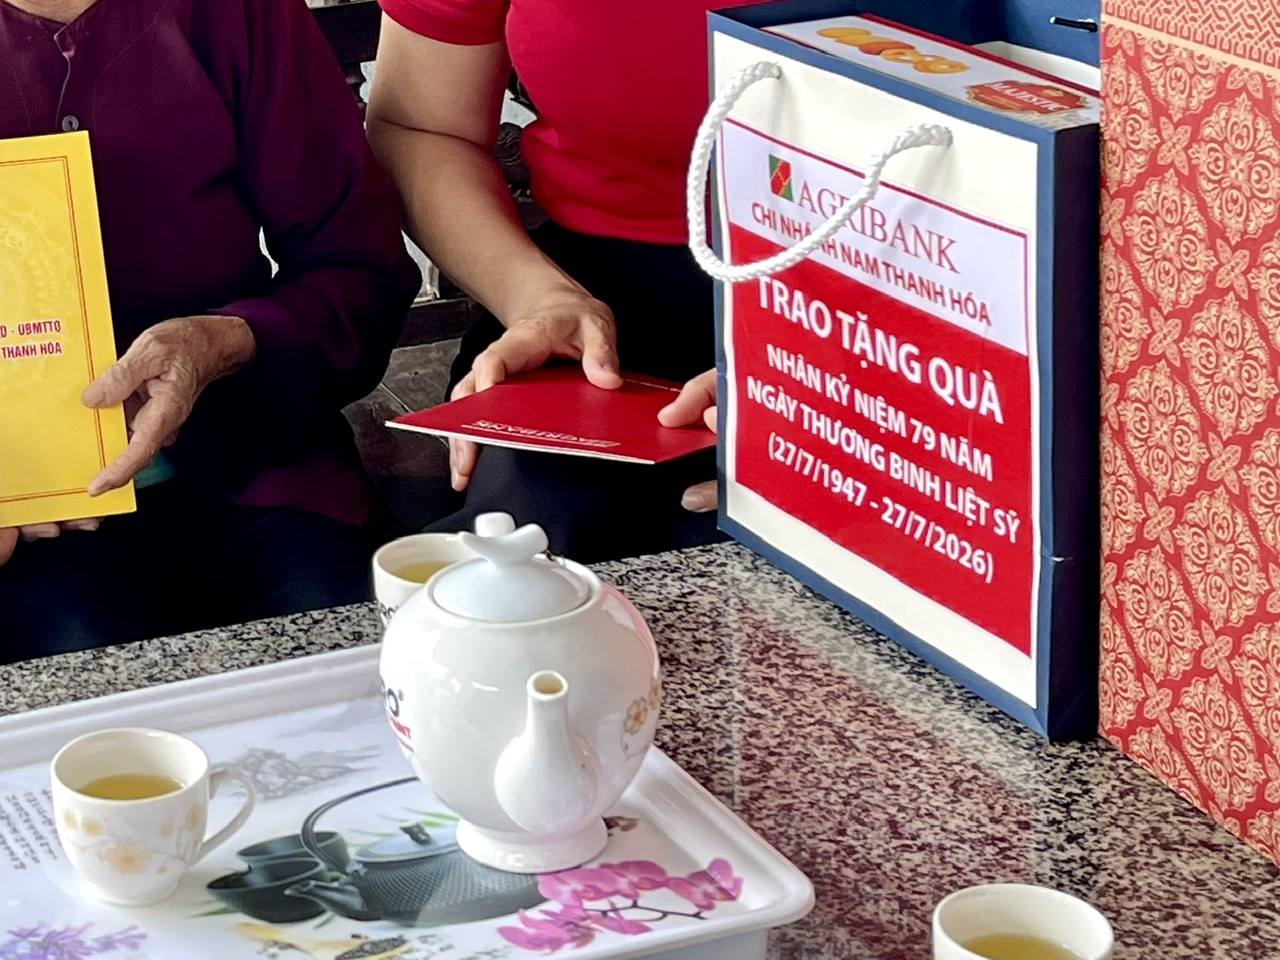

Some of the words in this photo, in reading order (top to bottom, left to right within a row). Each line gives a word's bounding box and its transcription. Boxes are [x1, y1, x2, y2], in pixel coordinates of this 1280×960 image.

[751, 201, 777, 232] CHI
[840, 242, 880, 280] NAM
[882, 260, 946, 307] THANH
[949, 287, 993, 327] HÓA
[1, 343, 37, 359] THANH
[759, 275, 833, 339] TRAO
[835, 309, 921, 384] TẶNG
[928, 356, 1004, 424] QUÀ
[766, 343, 822, 394] NHÂN
[853, 388, 907, 438] NIỆM
[910, 418, 935, 451] 79
[940, 431, 993, 482] NĂM
[746, 375, 799, 422] NGÀY
[799, 402, 886, 469] THƯƠNG
[889, 449, 942, 503] BINH
[944, 480, 991, 526] LIỆT
[768, 431, 868, 510] (27/7/1947
[881, 495, 994, 583] 27/7/2026)
